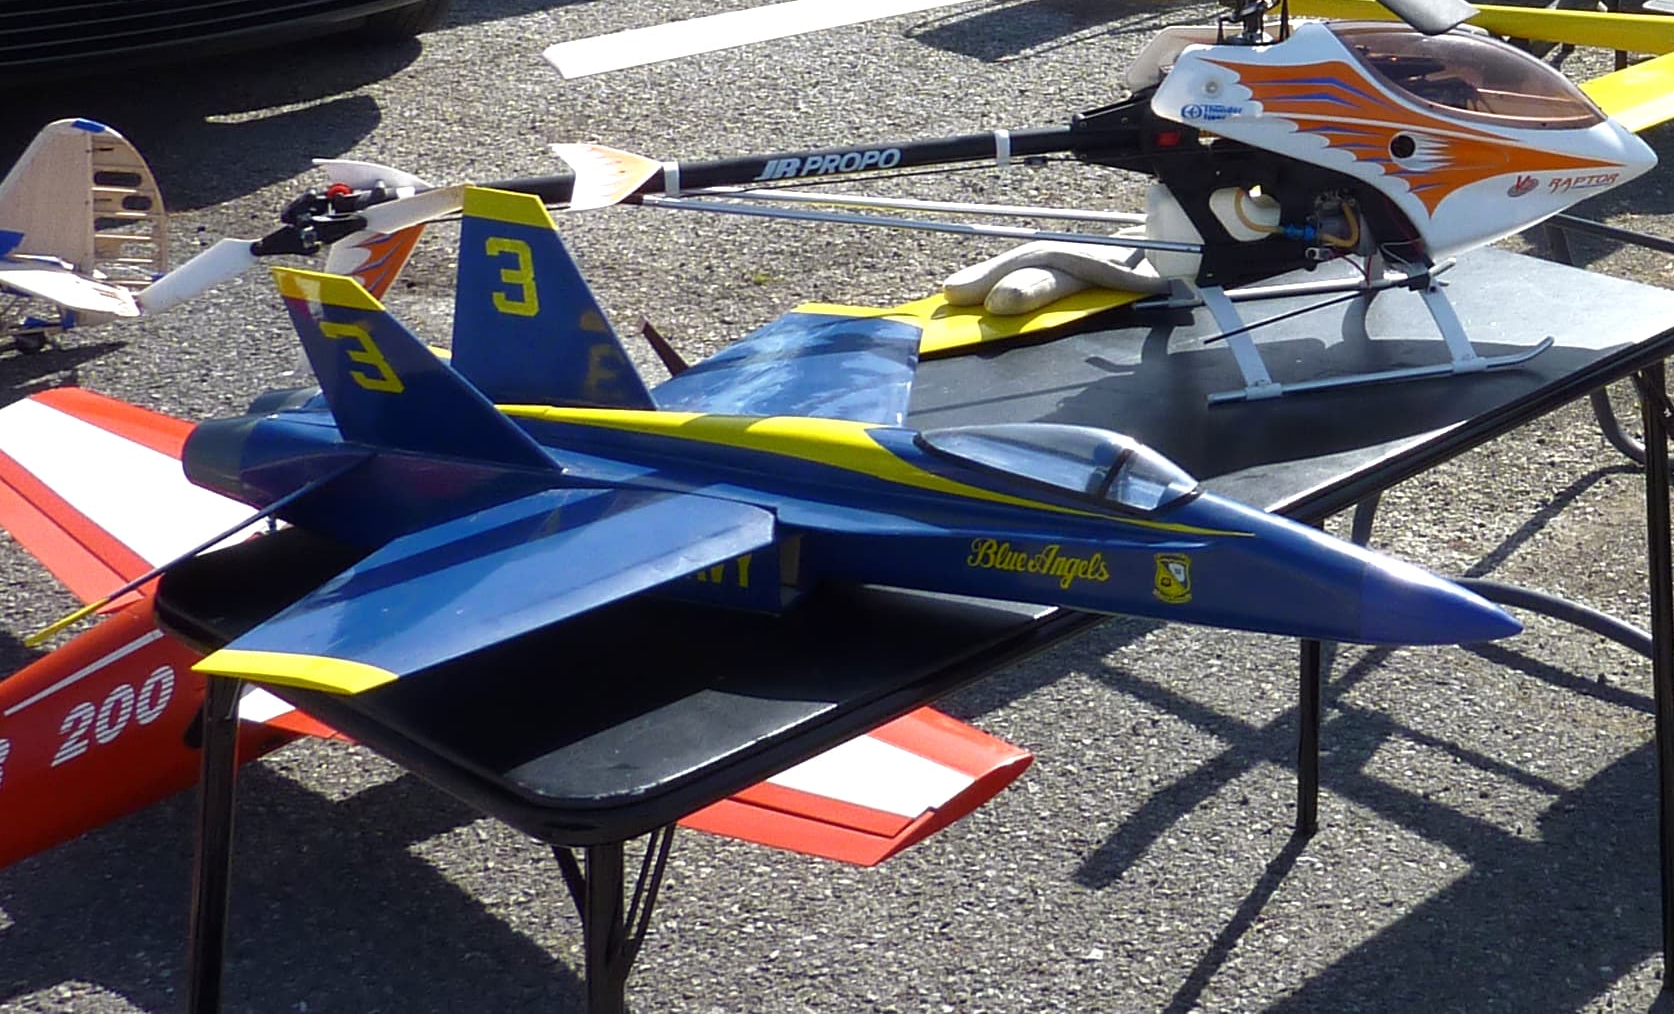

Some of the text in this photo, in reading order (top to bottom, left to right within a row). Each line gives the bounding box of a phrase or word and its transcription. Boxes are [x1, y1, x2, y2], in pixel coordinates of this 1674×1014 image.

[752, 147, 902, 182] JR PROPO
[1547, 172, 1620, 194] RAPTOR
[485, 236, 540, 317] 3
[319, 320, 405, 395] 3
[966, 537, 1111, 590] Blue Angels
[50, 664, 175, 768] 200
